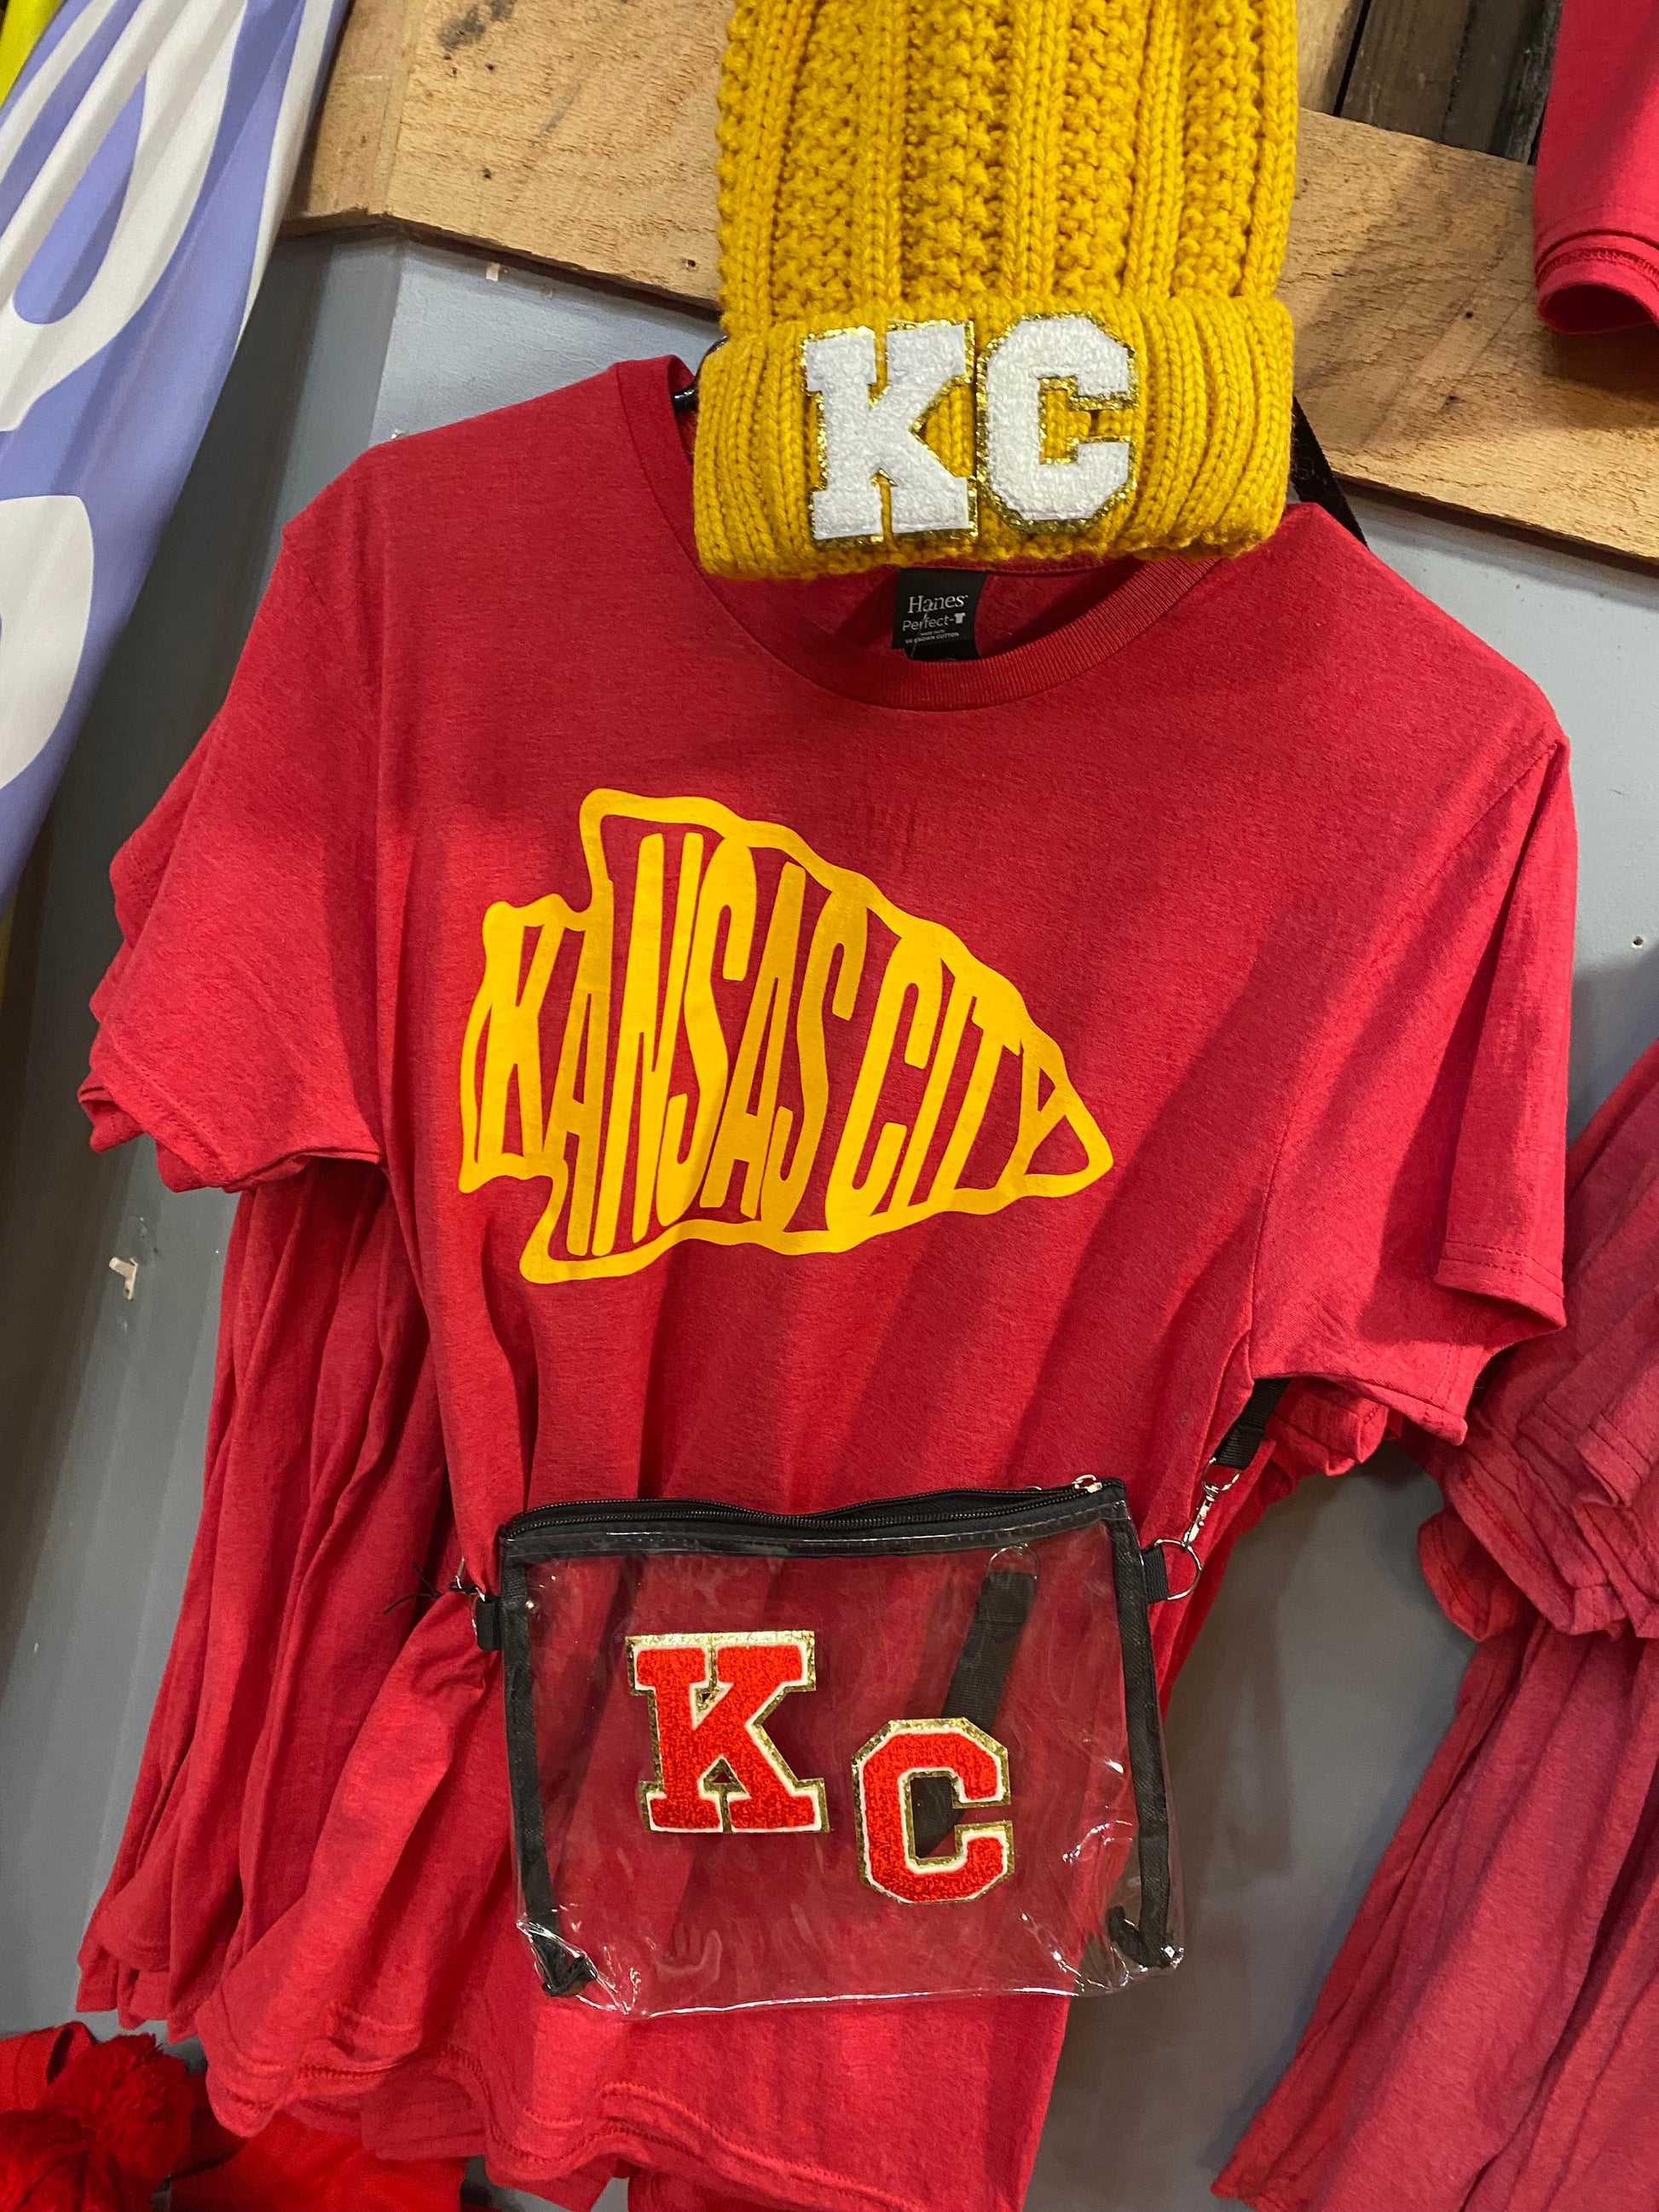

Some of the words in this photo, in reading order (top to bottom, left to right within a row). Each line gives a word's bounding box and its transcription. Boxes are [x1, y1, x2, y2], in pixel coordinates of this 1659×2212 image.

[800, 312, 1140, 549] KC
[907, 594, 965, 614] Hanes
[477, 829, 868, 1256] KANSAS
[826, 932, 1076, 1227] CITY
